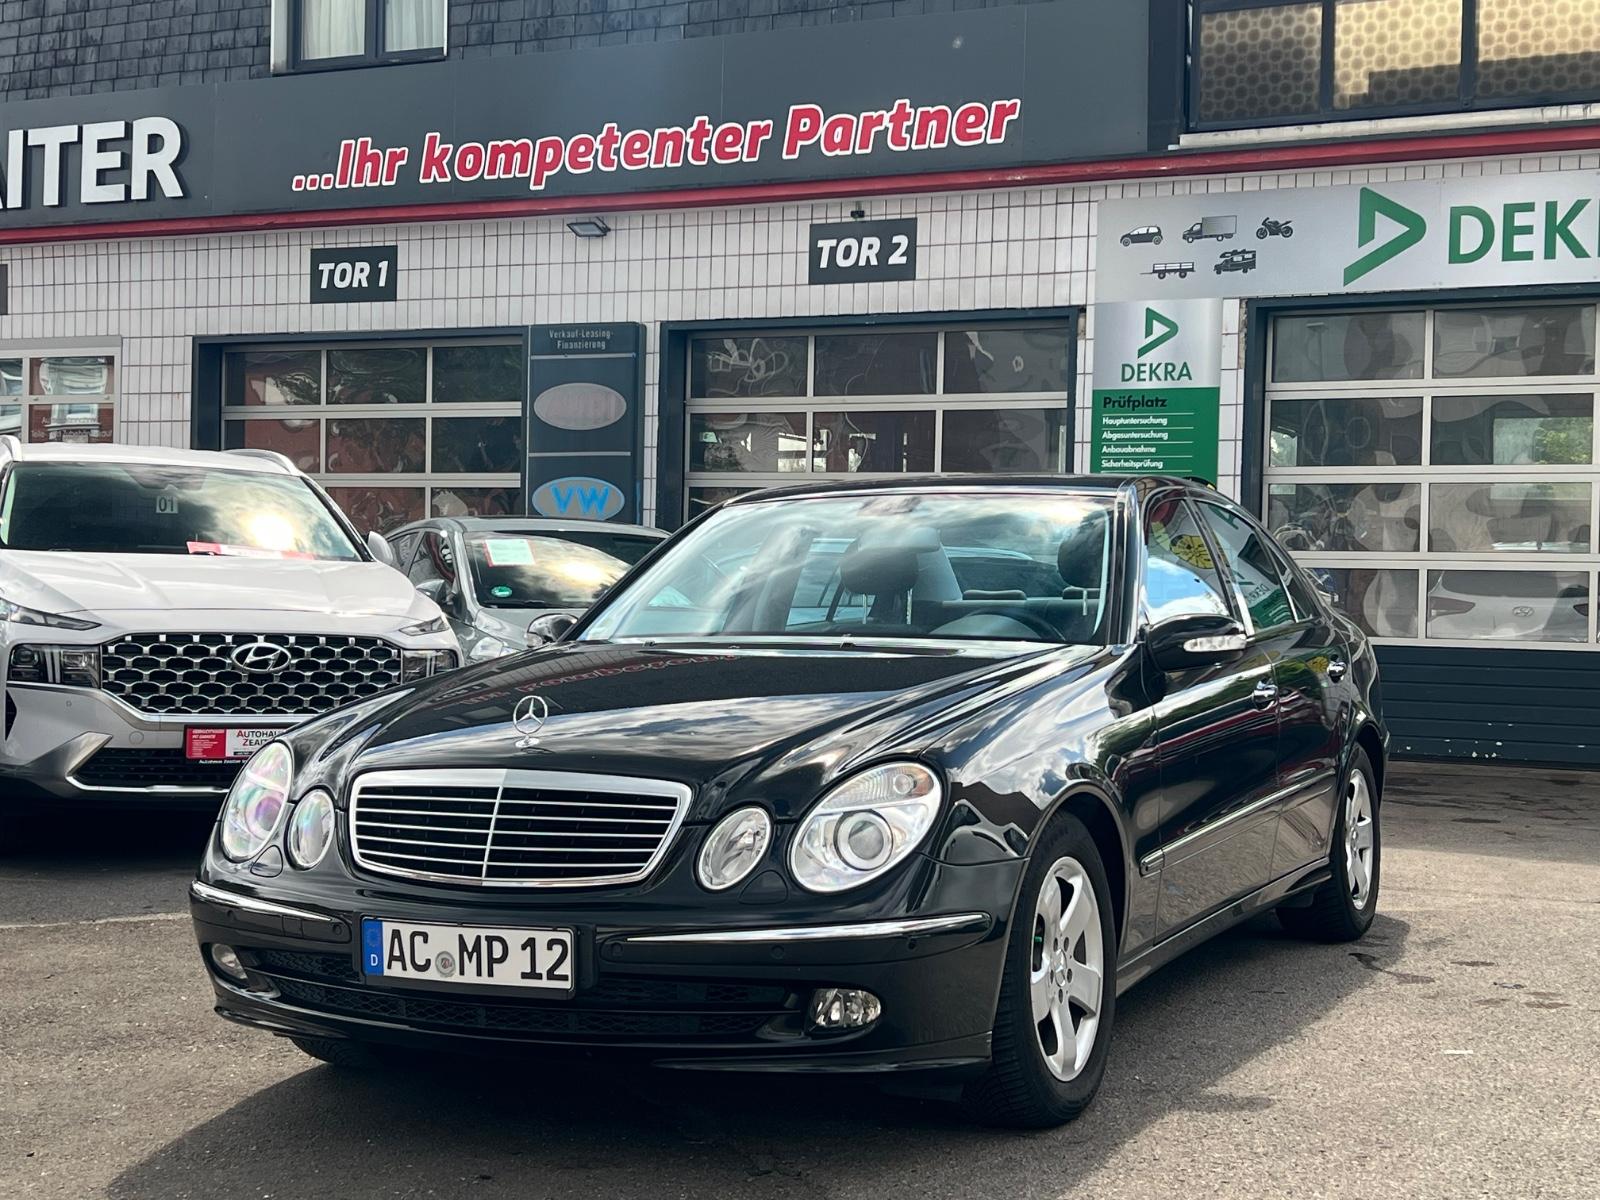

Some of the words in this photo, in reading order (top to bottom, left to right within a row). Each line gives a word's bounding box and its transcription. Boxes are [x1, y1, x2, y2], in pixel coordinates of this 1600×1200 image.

[419, 115, 773, 191] kompetenter
[782, 98, 1021, 160] Partner
[0, 116, 184, 210] ITER
[1448, 198, 1600, 265] DEK
[817, 236, 881, 268] TOR
[887, 234, 908, 265] 2
[318, 261, 370, 289] TOR
[378, 260, 389, 287] 1
[557, 340, 606, 350] Finanzierung
[1121, 361, 1192, 382] DEKRA
[1103, 395, 1168, 411] Prüfplatz
[1102, 416, 1168, 426] Hauptuntersuchung
[1102, 430, 1169, 440] Abgasuntersuchung
[1102, 445, 1157, 453] Anbauabnahme
[1101, 458, 1164, 469] Sicherheitsprüfung
[158, 496, 175, 512] 01
[550, 484, 609, 513] VW
[236, 730, 277, 738] AUTOHA
[370, 953, 379, 967] D
[386, 928, 432, 973] AC
[458, 933, 509, 978] MP
[520, 937, 569, 982] 12
